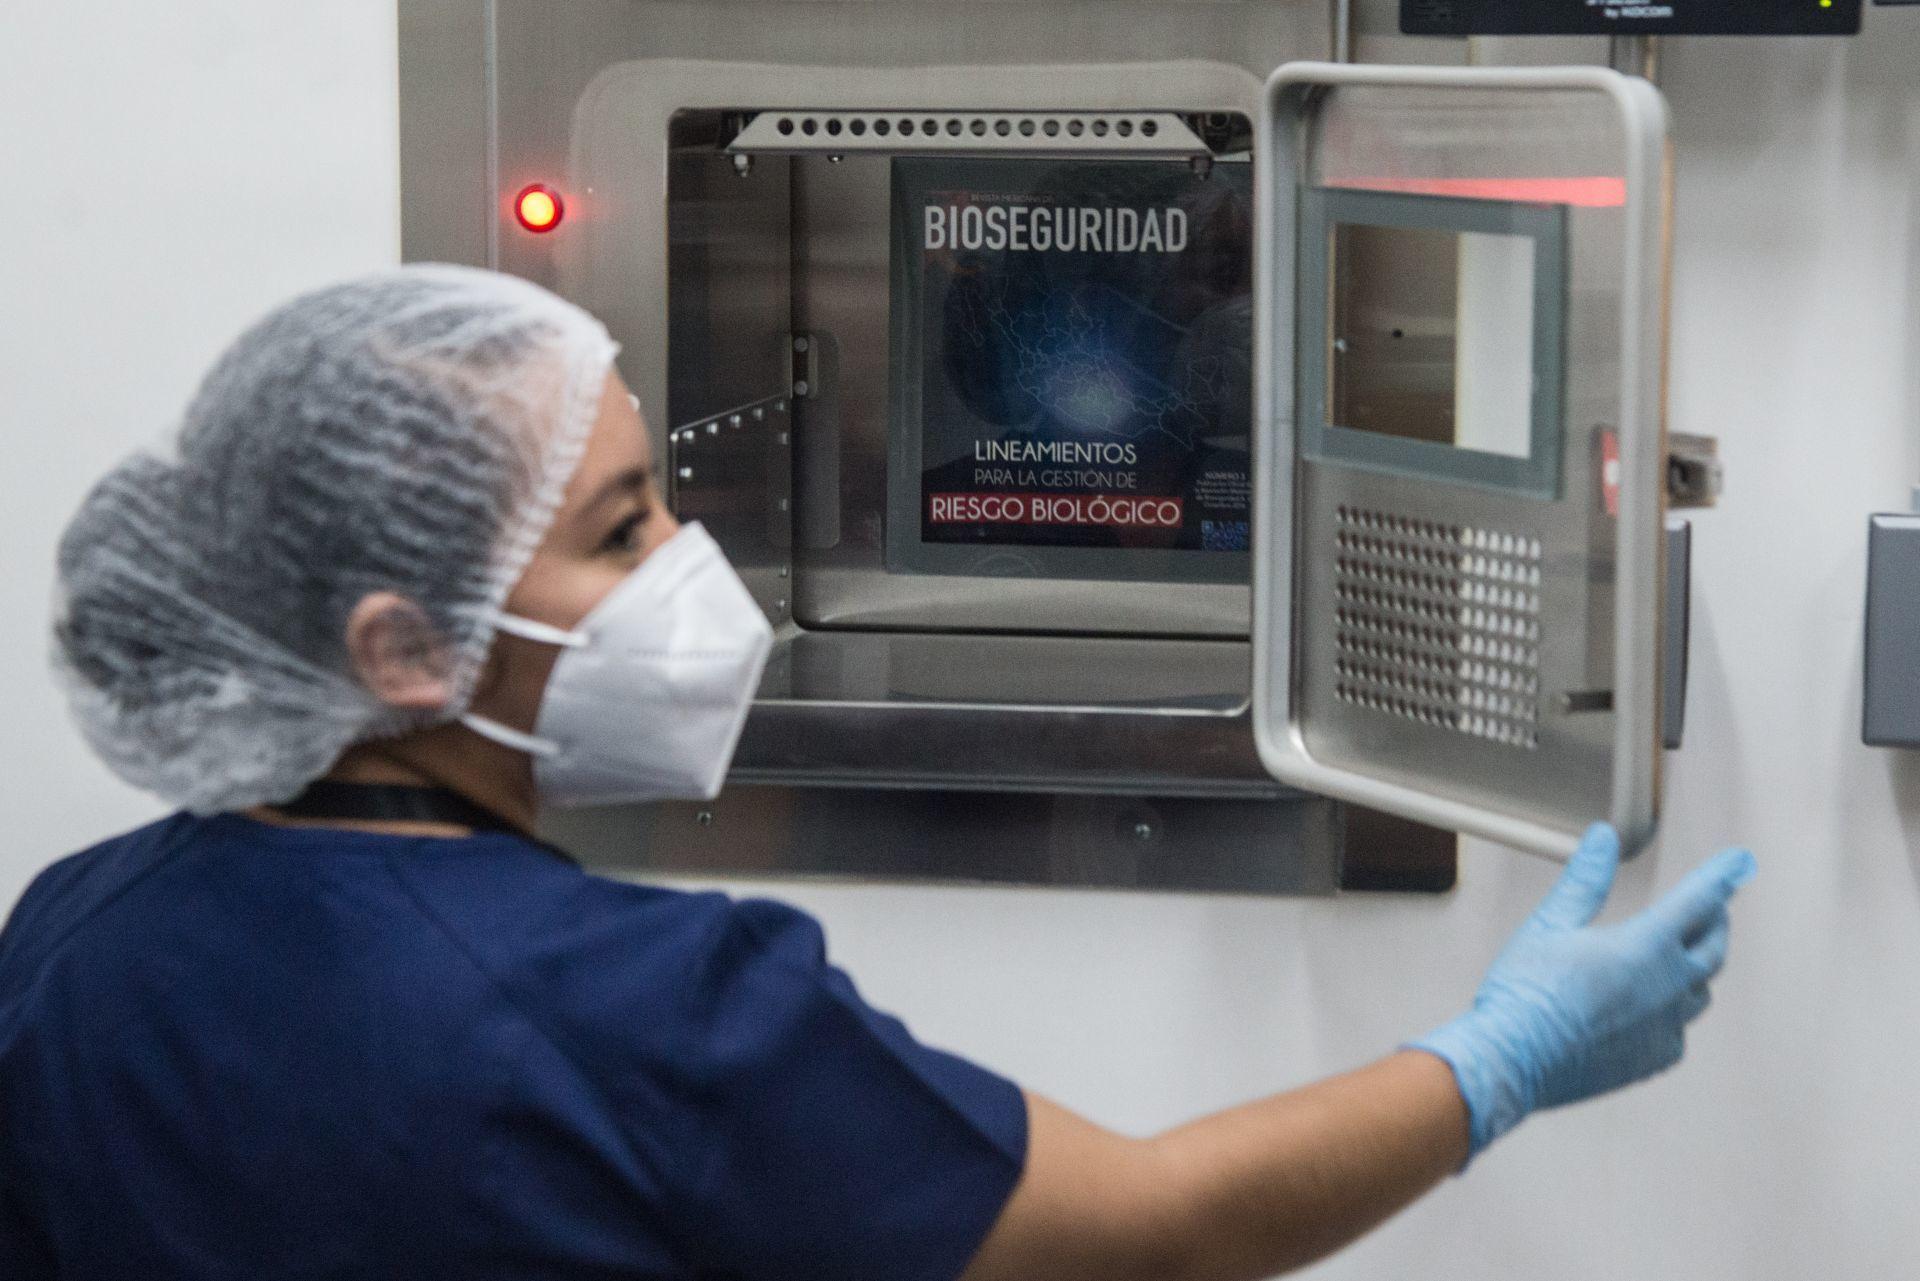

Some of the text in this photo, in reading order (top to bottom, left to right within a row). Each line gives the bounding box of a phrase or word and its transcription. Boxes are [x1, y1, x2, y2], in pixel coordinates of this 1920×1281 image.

[924, 205, 1188, 253] BIOSEGURIDAD
[974, 440, 1137, 465] LINEAMIENTOS
[974, 468, 1137, 489] PARA LA GESTIÓN DE
[932, 494, 1181, 525] RIESGO BIOLÓGICO
